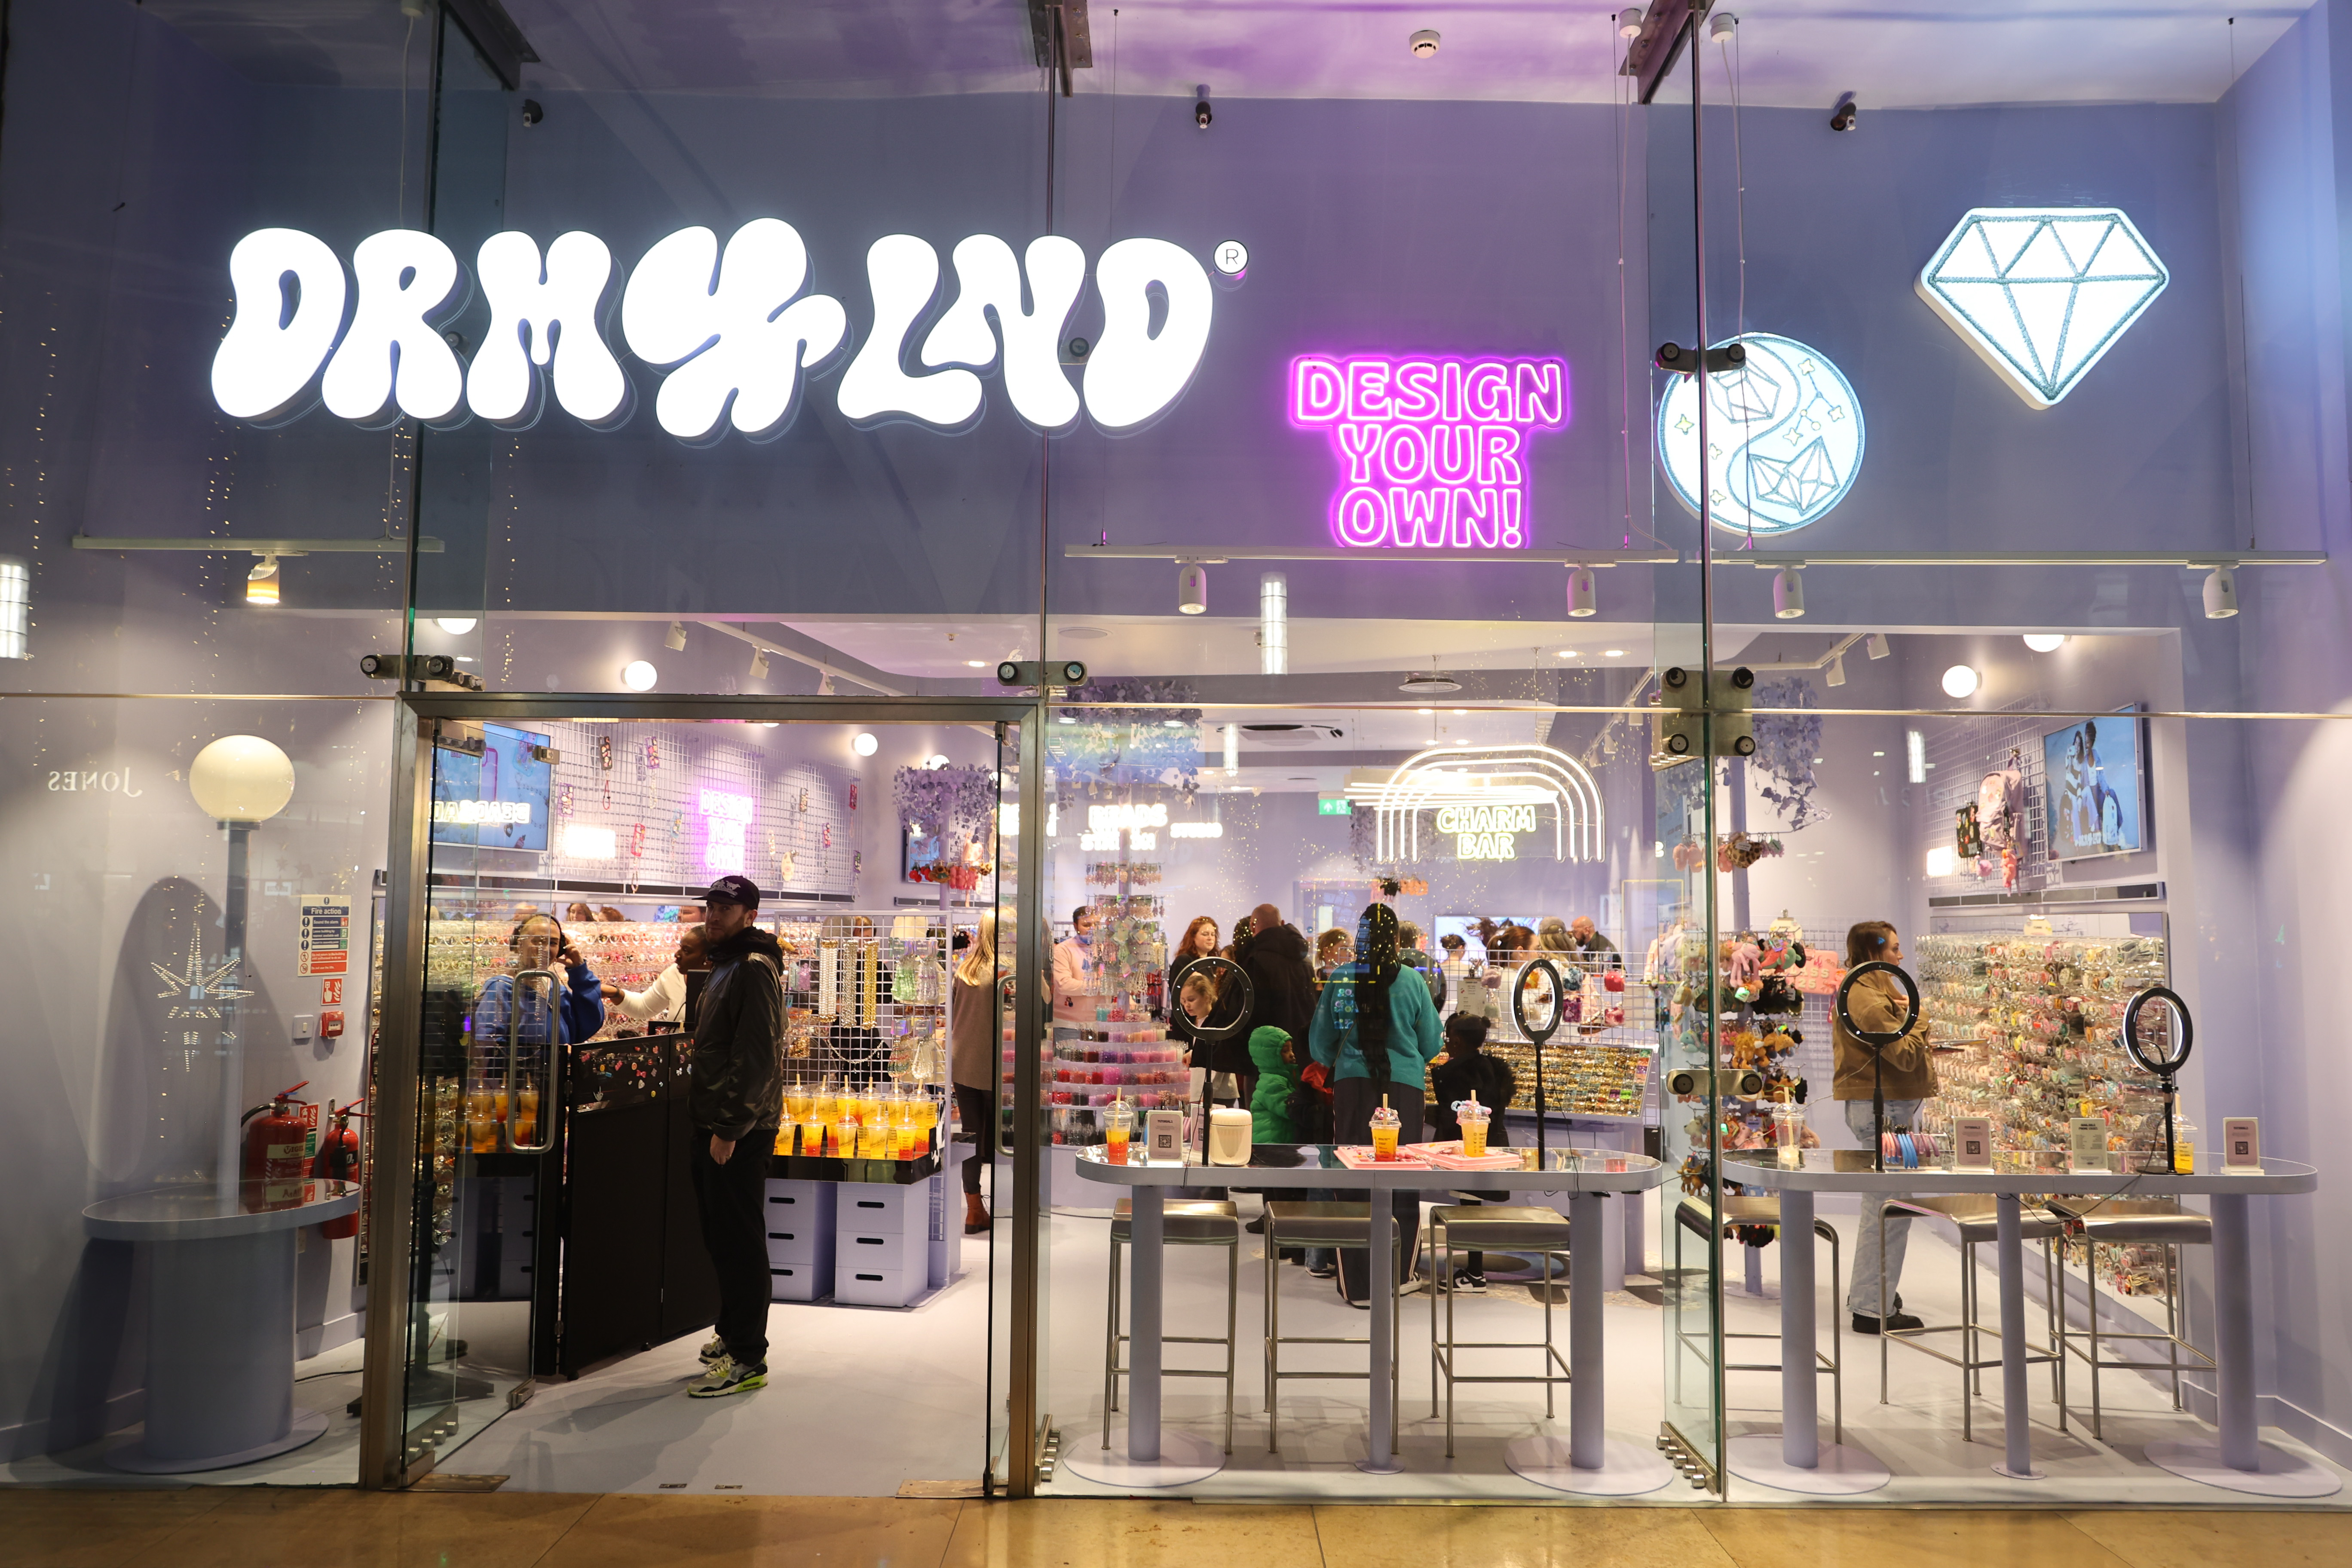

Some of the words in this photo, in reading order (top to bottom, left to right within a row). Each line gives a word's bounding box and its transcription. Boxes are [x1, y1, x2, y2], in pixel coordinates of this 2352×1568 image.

[1298, 361, 1562, 422] DESIGN
[1339, 424, 1521, 484] YOUR
[1338, 486, 1522, 548] OWN!
[701, 789, 753, 824] DESIGN
[1437, 805, 1536, 833] CHARM
[1457, 833, 1515, 859] BAR
[1790, 967, 1830, 979] LASS
[1798, 978, 1816, 989] 25
